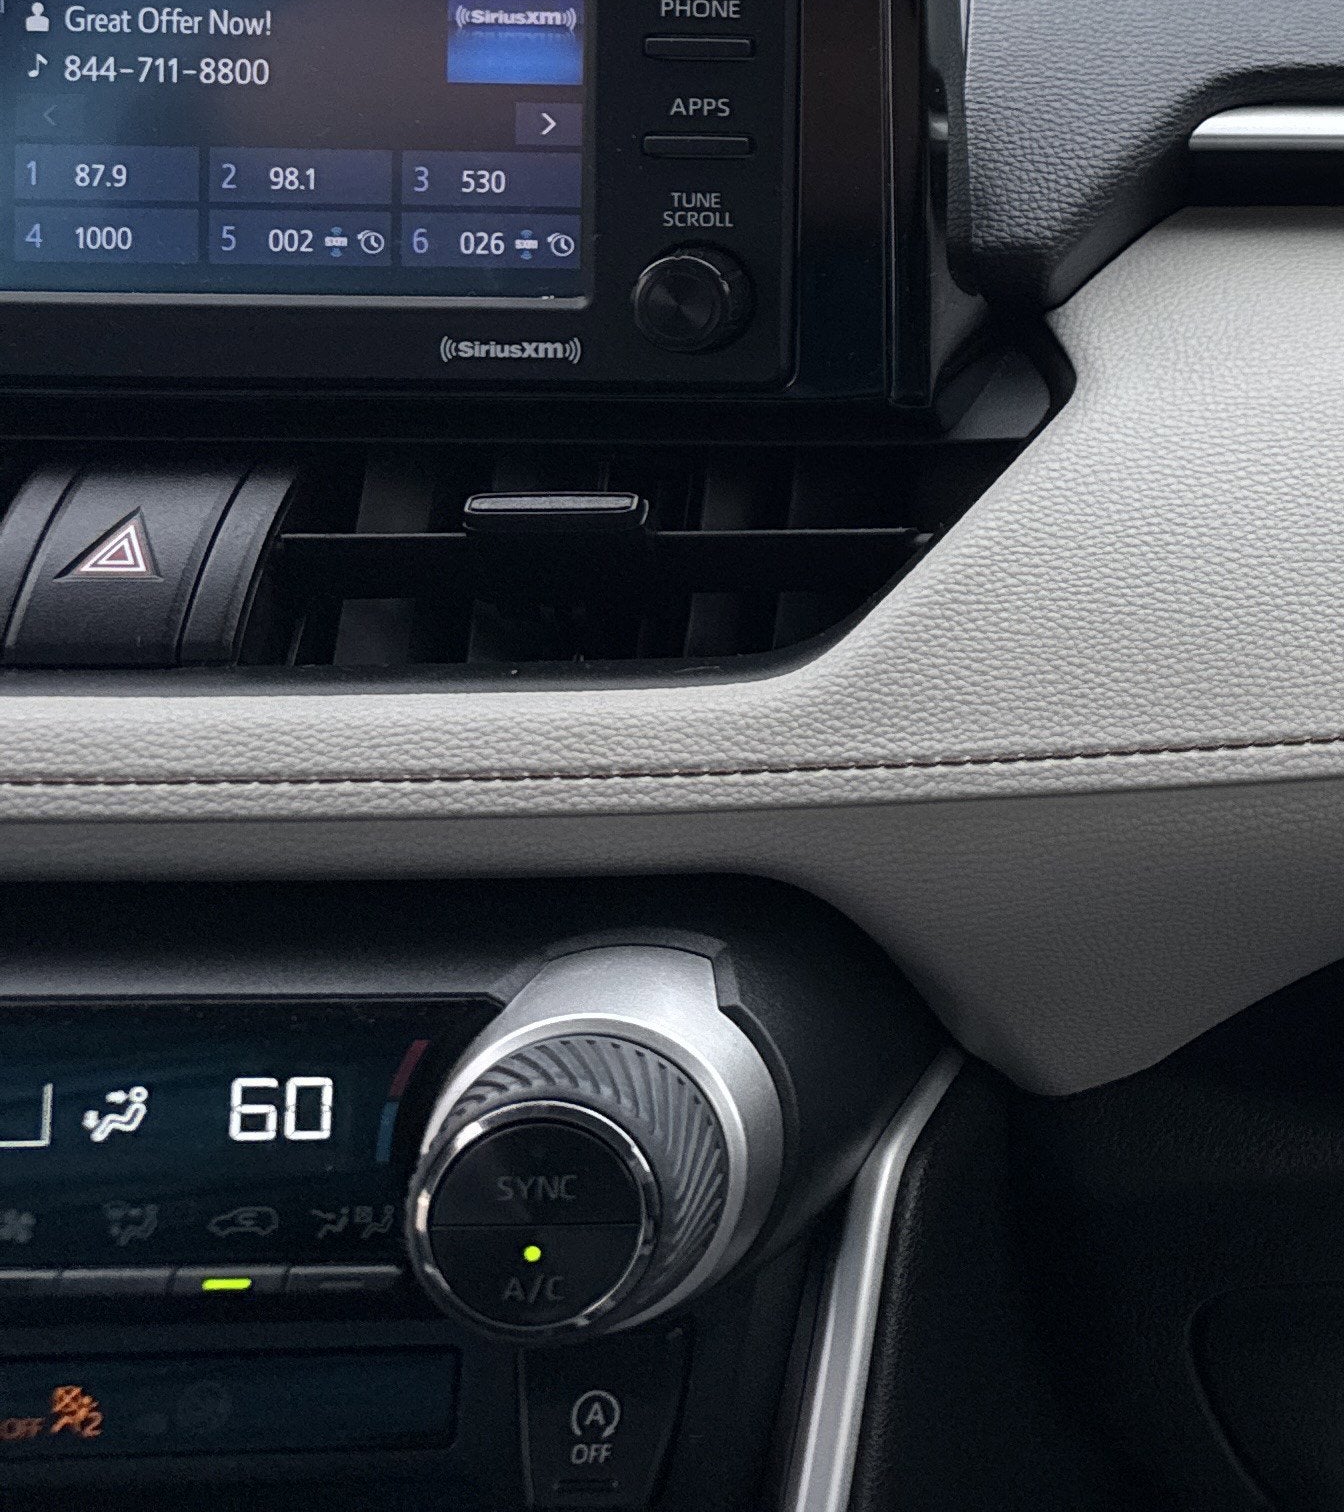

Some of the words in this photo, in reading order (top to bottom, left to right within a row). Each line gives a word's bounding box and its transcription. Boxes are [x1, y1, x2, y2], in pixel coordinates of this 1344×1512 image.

[64, 5, 132, 33] Great
[137, 6, 203, 34] Offer
[208, 8, 272, 36] Now!
[660, 0, 741, 18] PHONE
[64, 55, 270, 85] 844-711-8800
[669, 98, 731, 117] APPS
[26, 160, 38, 186] 1
[74, 164, 128, 187] 87.9
[221, 163, 237, 189] 2
[269, 167, 316, 190] 98.1
[413, 166, 429, 192] 3
[461, 170, 506, 193] 530
[671, 192, 722, 208] TUNE
[662, 211, 735, 227] SCROLL
[25, 223, 43, 248] 4
[74, 226, 133, 250] 1000
[221, 225, 237, 251] 5
[268, 229, 314, 252] 002
[412, 228, 429, 254] 6
[460, 232, 505, 255] 026
[229, 1076, 334, 1142] 60
[497, 1174, 577, 1201] SYNC
[503, 1273, 564, 1304] A/C
[571, 1443, 612, 1465] OFF
